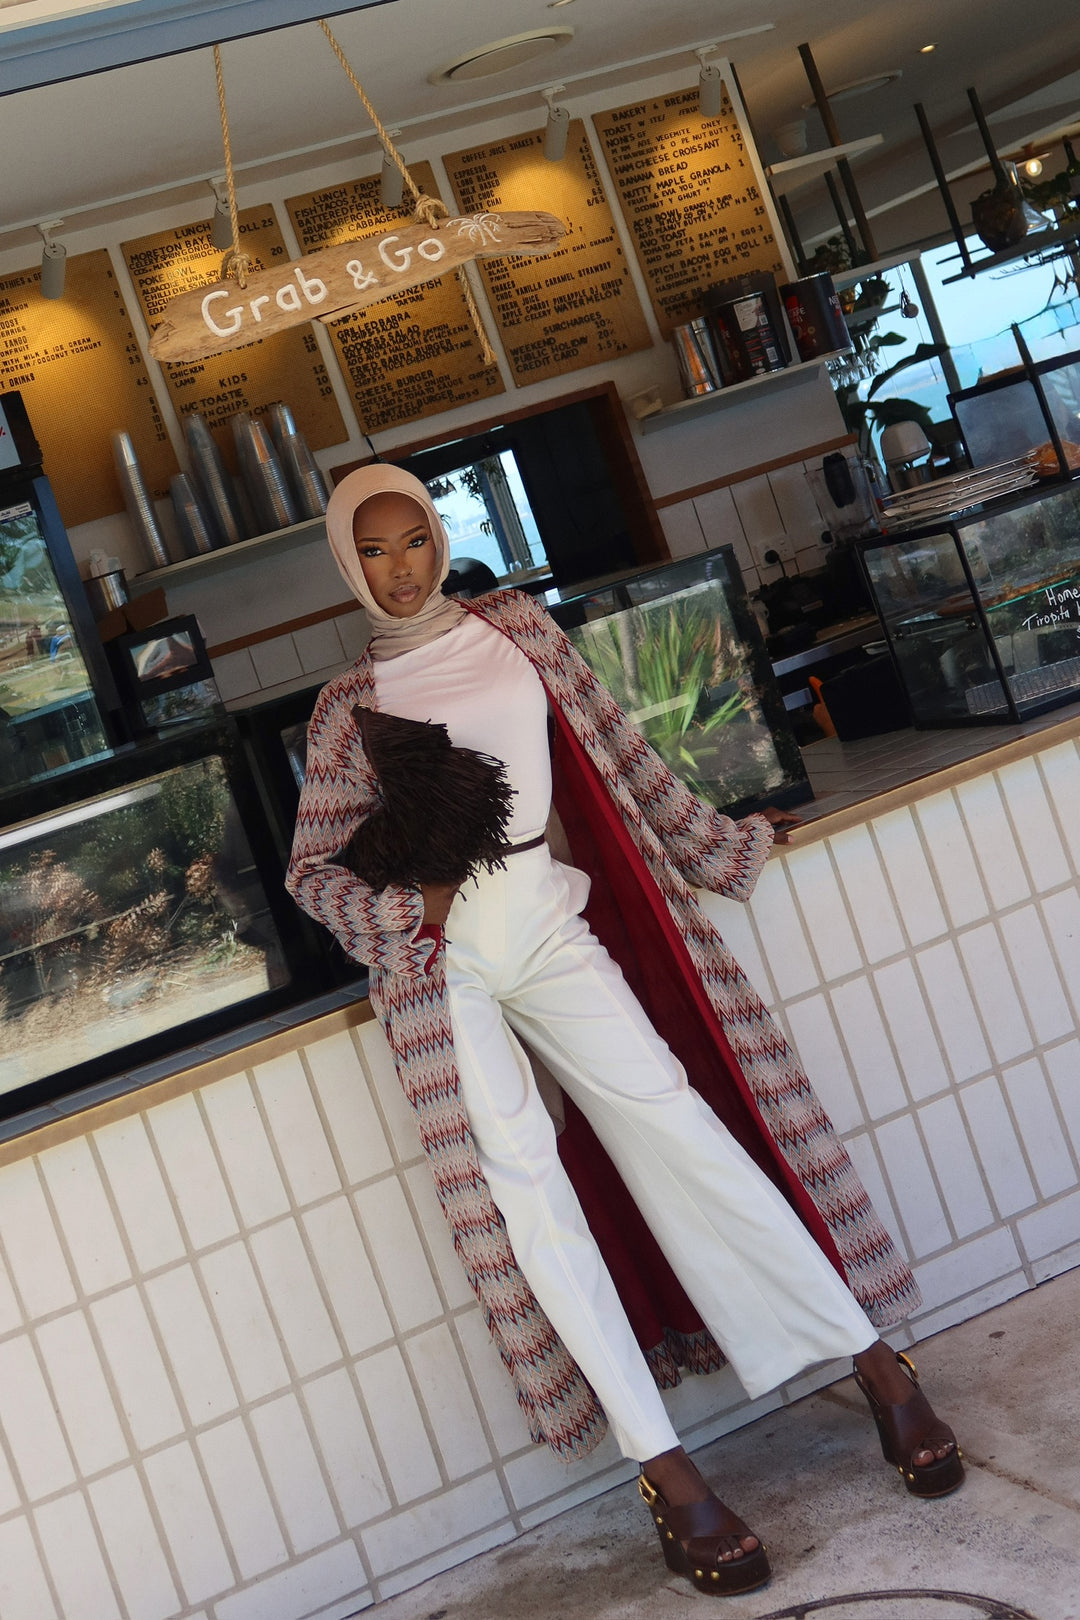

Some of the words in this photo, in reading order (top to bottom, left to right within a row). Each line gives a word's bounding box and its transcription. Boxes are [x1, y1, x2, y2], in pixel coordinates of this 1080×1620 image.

[611, 105, 647, 122] BAKERY
[602, 122, 632, 137] TOAST
[655, 127, 690, 142] VEGEMITE
[461, 150, 485, 163] COFFEE
[488, 145, 506, 156] JUICE
[509, 137, 533, 150] SHAKES
[672, 138, 720, 158] CROISSANT
[730, 133, 741, 142] 12
[453, 164, 486, 179] ESPRESSO
[456, 176, 474, 188] LONG
[476, 170, 497, 182] BLACK
[618, 169, 654, 187] BANANA
[658, 161, 688, 175] BREAD
[621, 184, 652, 200] NUTTY
[656, 175, 685, 189] MAPLE
[689, 162, 730, 180] GRANOLA
[312, 188, 347, 204] LUNCH
[353, 179, 381, 192] FROM
[459, 185, 476, 196] MILK
[479, 178, 500, 190] BASED
[462, 195, 474, 204] HOT
[477, 190, 494, 200] CHOC
[294, 206, 317, 218] FISH
[319, 197, 348, 211] TACOS
[297, 206, 349, 227] BATTERED
[349, 200, 371, 213] FISH
[364, 206, 385, 217] RUM
[464, 202, 483, 213] DIRTY
[486, 197, 501, 206] CHAI
[174, 222, 211, 239] LUNCH
[303, 227, 343, 244] PICKLED
[638, 237, 657, 249] AVO
[661, 228, 686, 242] TOAST
[753, 206, 764, 215] 15
[129, 242, 182, 263] MORETON
[184, 235, 205, 247] BAY
[260, 217, 273, 227] 25
[129, 256, 158, 270] CELERY
[138, 274, 163, 287] POKE
[270, 246, 283, 255] 20
[483, 258, 504, 270] LOOSE
[647, 263, 675, 278] SPICY
[680, 253, 709, 268] BACON
[713, 247, 730, 258] EGG
[735, 238, 759, 251] ROLL
[762, 234, 773, 243] 15
[143, 289, 171, 302] CHILLI
[171, 277, 213, 294] DRESSING
[247, 263, 265, 273] RICE
[182, 273, 203, 283] TUNA
[200, 268, 329, 338] Grab
[347, 260, 378, 290] &
[378, 237, 445, 272] Go
[419, 277, 442, 291] FISH
[490, 280, 515, 293] SHAKES
[495, 291, 512, 301] CHOC
[514, 281, 542, 295] VANILLA
[544, 272, 574, 286] CARAMEL
[497, 300, 518, 312] FRESH
[521, 294, 539, 305] JUICE
[502, 308, 522, 320] APPLE
[525, 300, 549, 313] CARROT
[552, 289, 586, 305] PINEAPPLE
[554, 288, 620, 313] WATERMELON
[657, 291, 688, 306] VEGGIE
[336, 320, 378, 339] GRILLED
[378, 311, 410, 326] BARRA
[542, 311, 601, 334] SURCHARGES
[342, 335, 385, 353] GODDESS
[387, 323, 420, 340] SALAD
[509, 336, 556, 356] WEEKEND
[2, 357, 19, 366] WITH
[23, 351, 39, 360] MILK
[52, 344, 64, 352] ICE
[68, 337, 91, 347] CREAM
[169, 364, 204, 379] CHICKEN
[302, 334, 313, 344] 15
[349, 360, 378, 376] FRIED
[380, 350, 412, 366] BARRA
[414, 339, 451, 355] BURGER
[513, 348, 547, 364] PUBLIC
[515, 357, 550, 373] CREDIT
[552, 348, 579, 361] CARD
[8, 372, 35, 386] DRINKS
[174, 376, 195, 387] LAMB
[200, 388, 243, 408] TOASTIE
[312, 364, 324, 374] 12
[218, 372, 247, 387] KIDS
[354, 383, 392, 400] CHEESE
[395, 369, 433, 387] BURGER
[485, 375, 496, 385] 15
[215, 397, 248, 414] CHIPS
[316, 375, 328, 384] 10
[319, 386, 331, 396] 10
[1022, 605, 1070, 630] Tiropita
